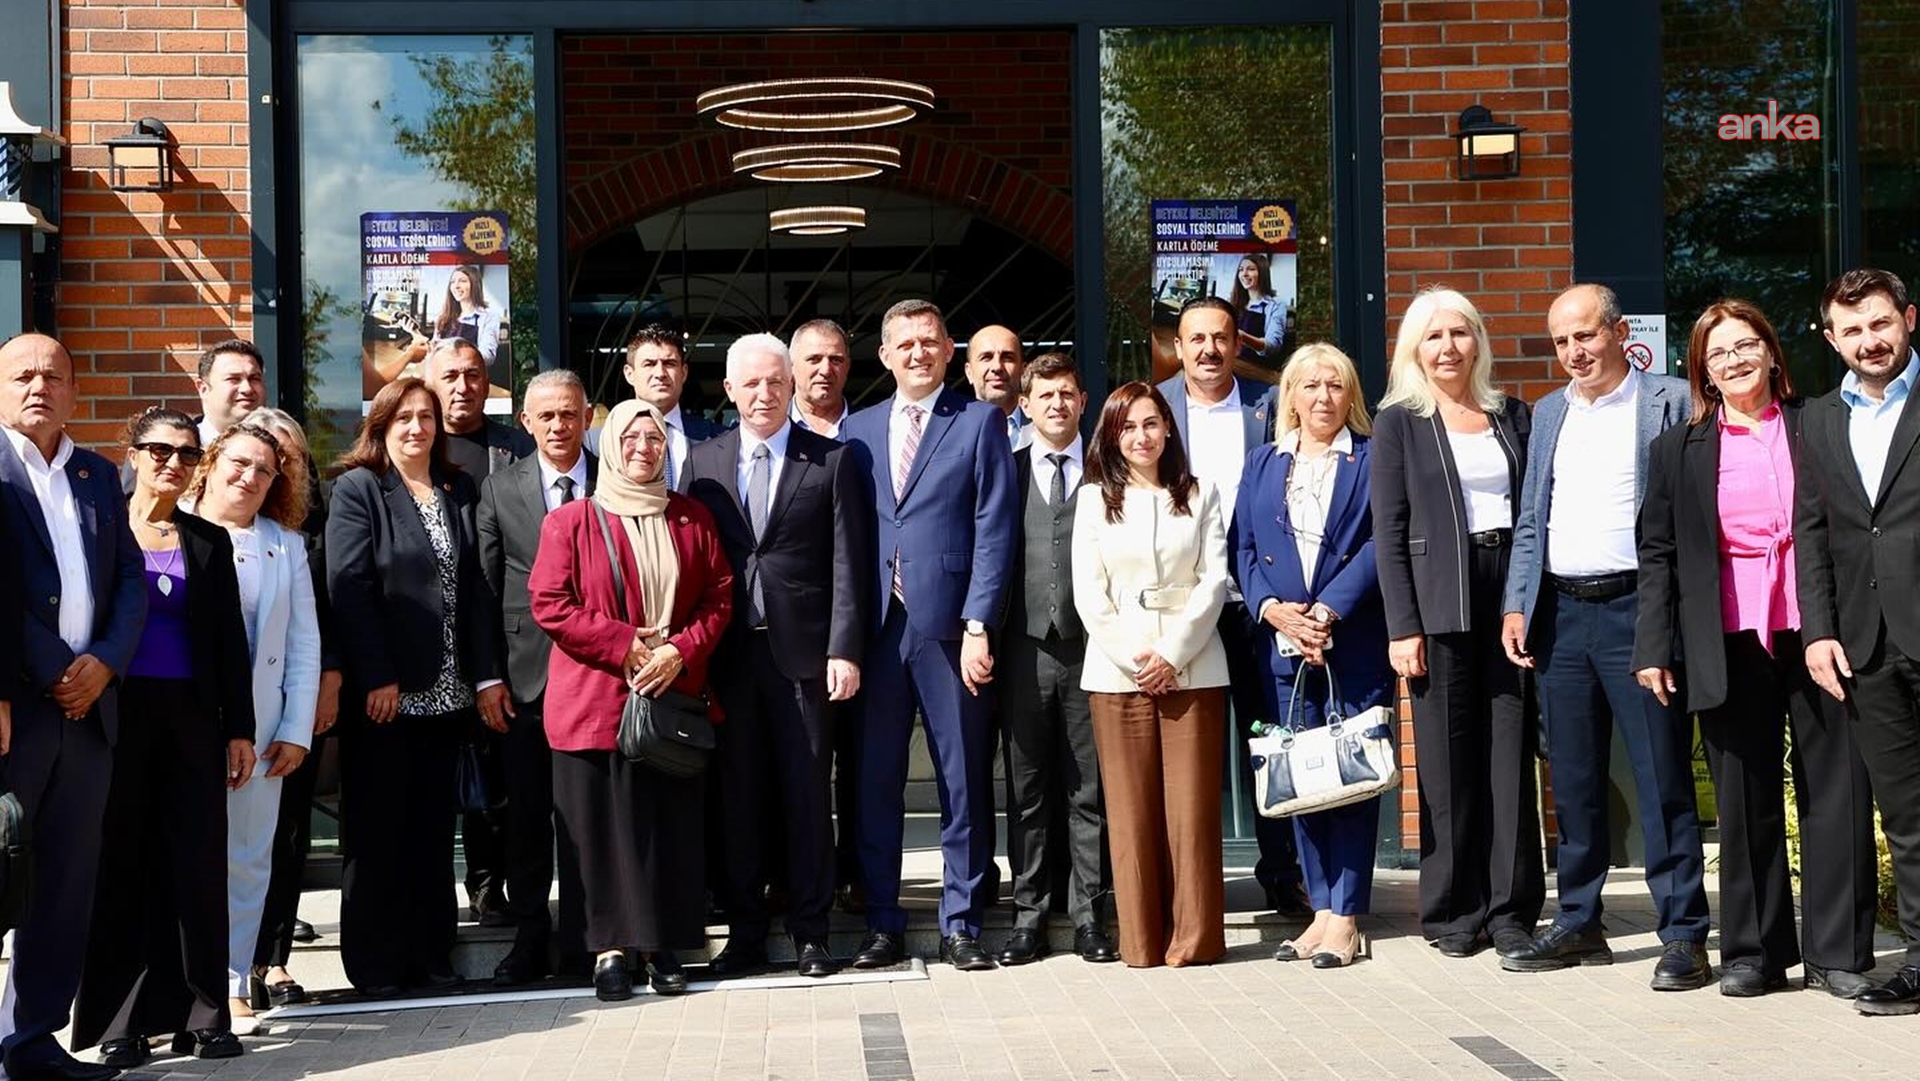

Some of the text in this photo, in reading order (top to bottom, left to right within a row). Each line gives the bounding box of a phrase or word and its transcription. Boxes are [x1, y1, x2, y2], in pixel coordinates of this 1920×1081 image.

[1156, 221, 1246, 235] SOSYAL TESİSLERİNDE
[366, 233, 456, 248] SOSYAL TESİSLERİNDE
[1156, 239, 1219, 252] KARTLA ÖDEME
[366, 252, 430, 264] KARTLA ÖDEME
